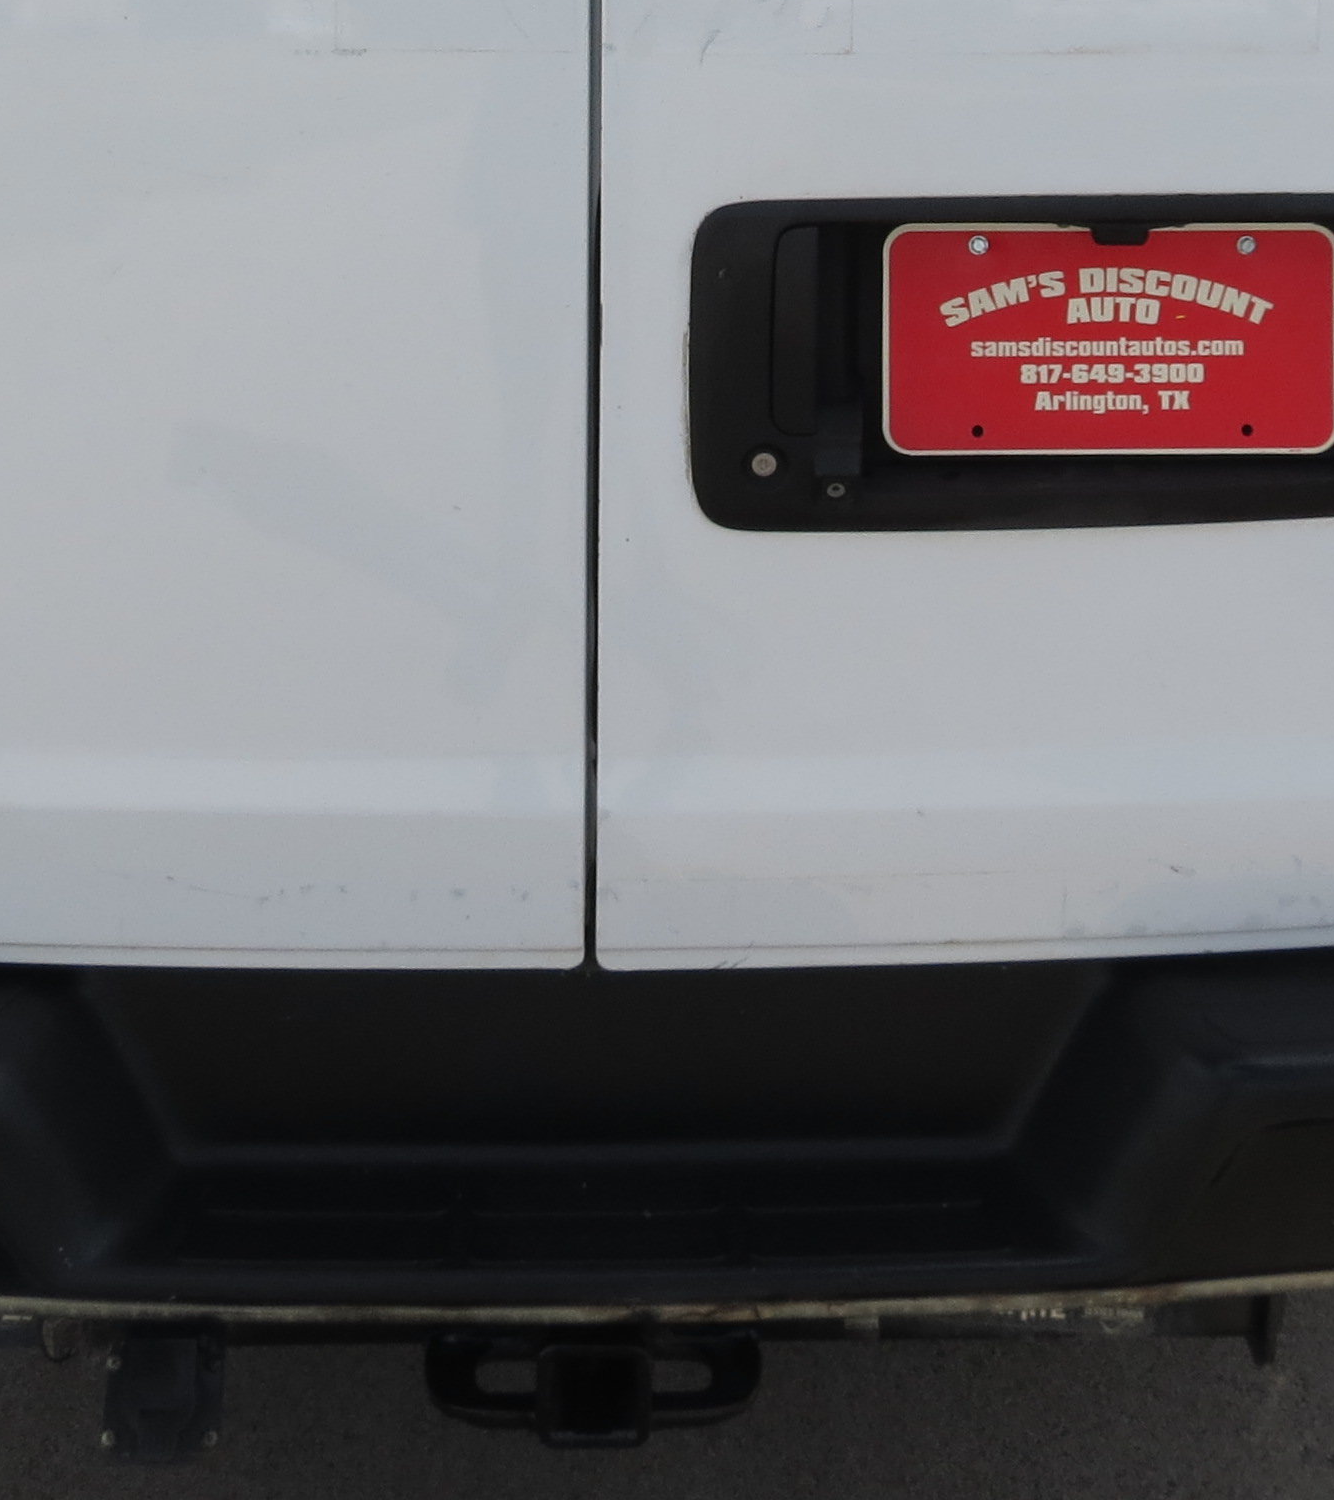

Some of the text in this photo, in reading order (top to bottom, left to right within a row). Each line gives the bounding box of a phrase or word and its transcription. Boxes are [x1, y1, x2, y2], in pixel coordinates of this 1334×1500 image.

[939, 267, 1275, 328] SAM'S DISCOUNT
[1067, 296, 1161, 325] AUTO
[970, 336, 1245, 358] samsdiscountautos.com
[1020, 363, 1205, 384] 817-649-3900
[1034, 390, 1191, 415] Arlington, TX
